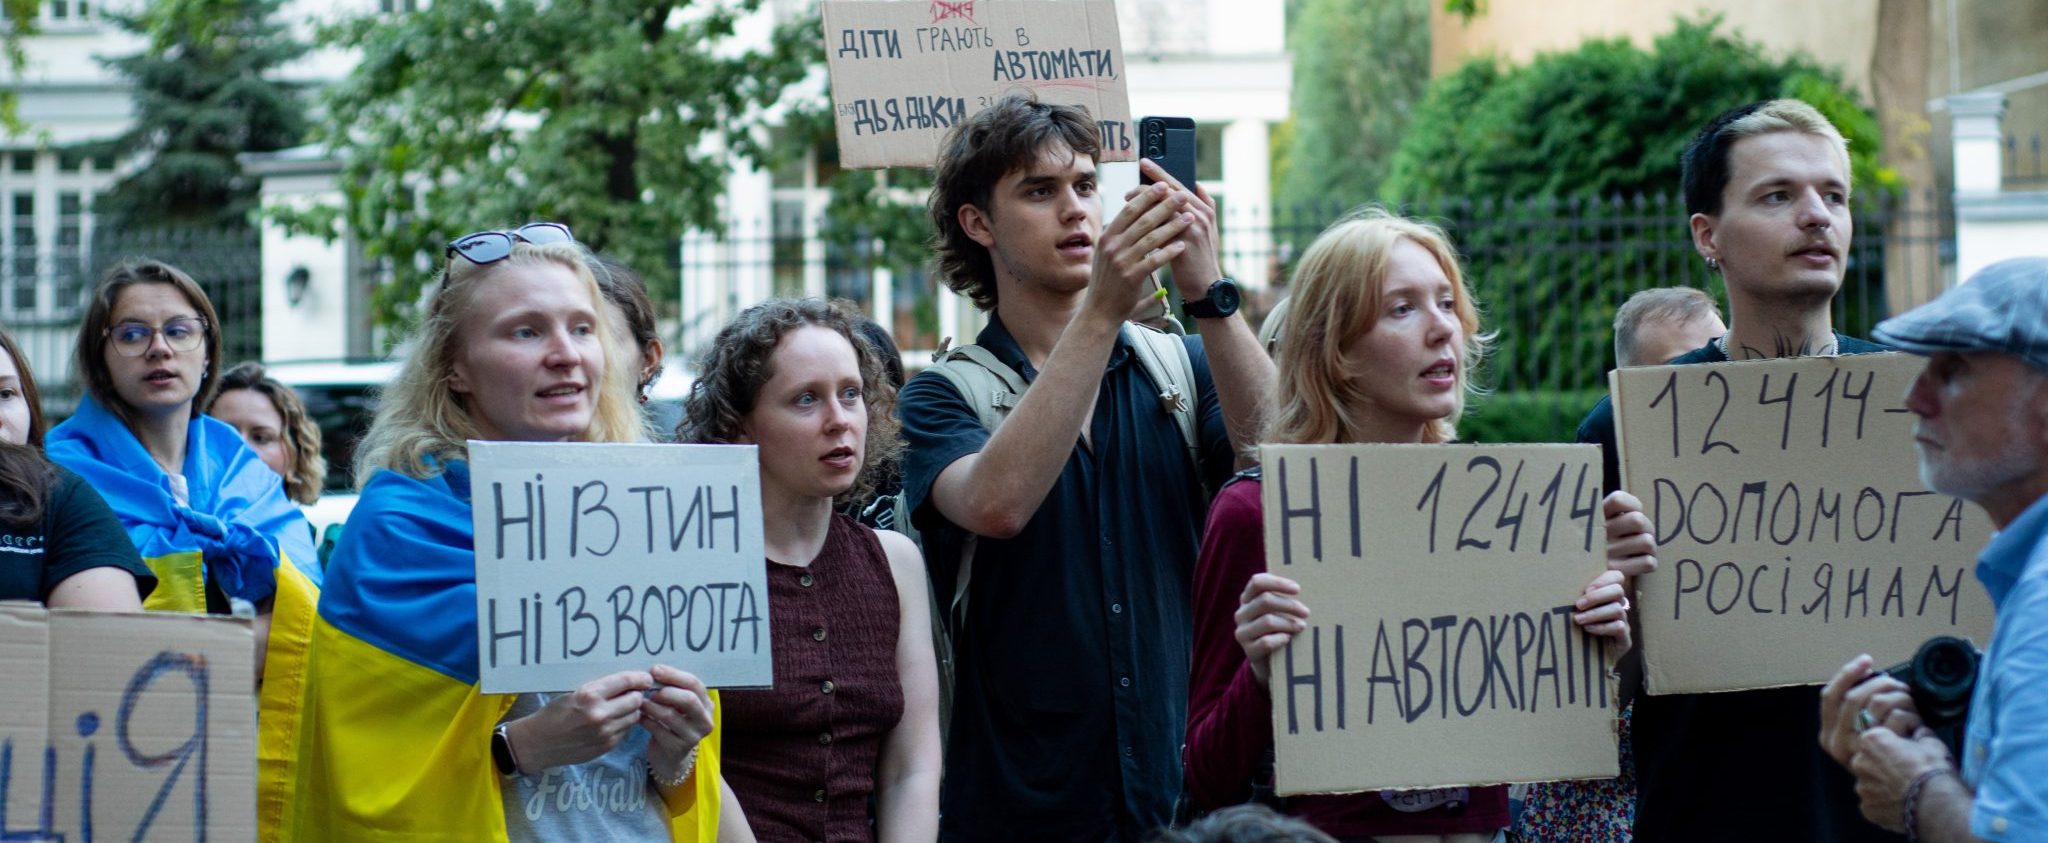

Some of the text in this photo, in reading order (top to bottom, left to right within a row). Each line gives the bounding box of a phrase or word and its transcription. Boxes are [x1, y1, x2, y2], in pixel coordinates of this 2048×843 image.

[839, 26, 1030, 60] ДІТИ ГРАЮТЬ В
[993, 48, 1119, 82] АВТОМАТИ,
[854, 95, 967, 136] ДЬЯДЬКИ
[569, 480, 621, 558] В
[628, 485, 740, 555] ТИН
[1278, 454, 1600, 566] НІ 12414
[555, 586, 601, 660] В
[606, 581, 763, 658] ВОРОТА
[1284, 624, 1346, 735] НІ
